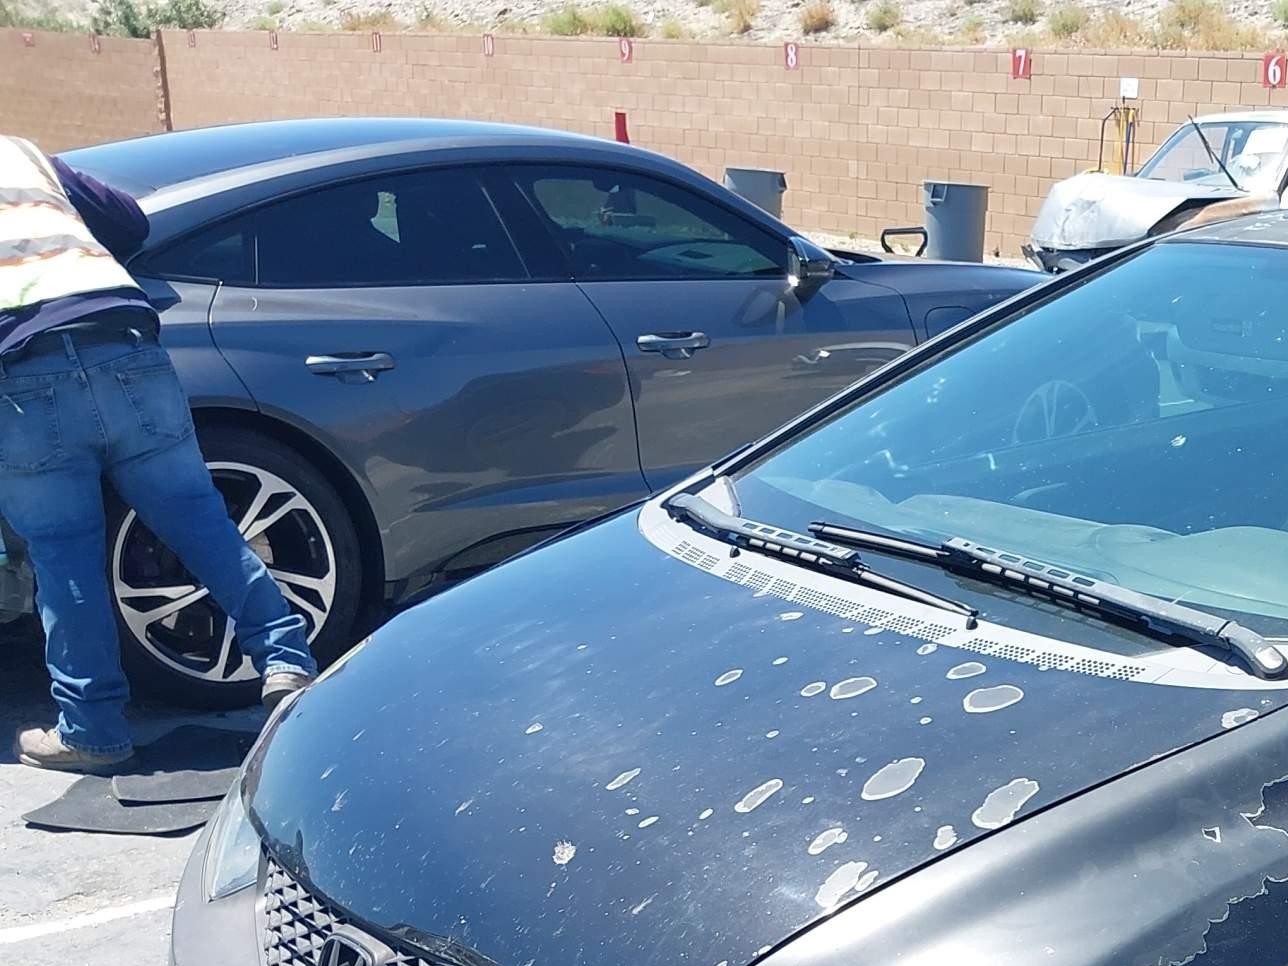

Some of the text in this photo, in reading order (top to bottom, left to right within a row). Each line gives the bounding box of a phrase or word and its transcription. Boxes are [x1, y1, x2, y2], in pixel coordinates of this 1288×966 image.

[621, 39, 630, 61] 9
[786, 43, 797, 69] 8
[1015, 49, 1026, 76] 7
[1267, 55, 1282, 85] 6
